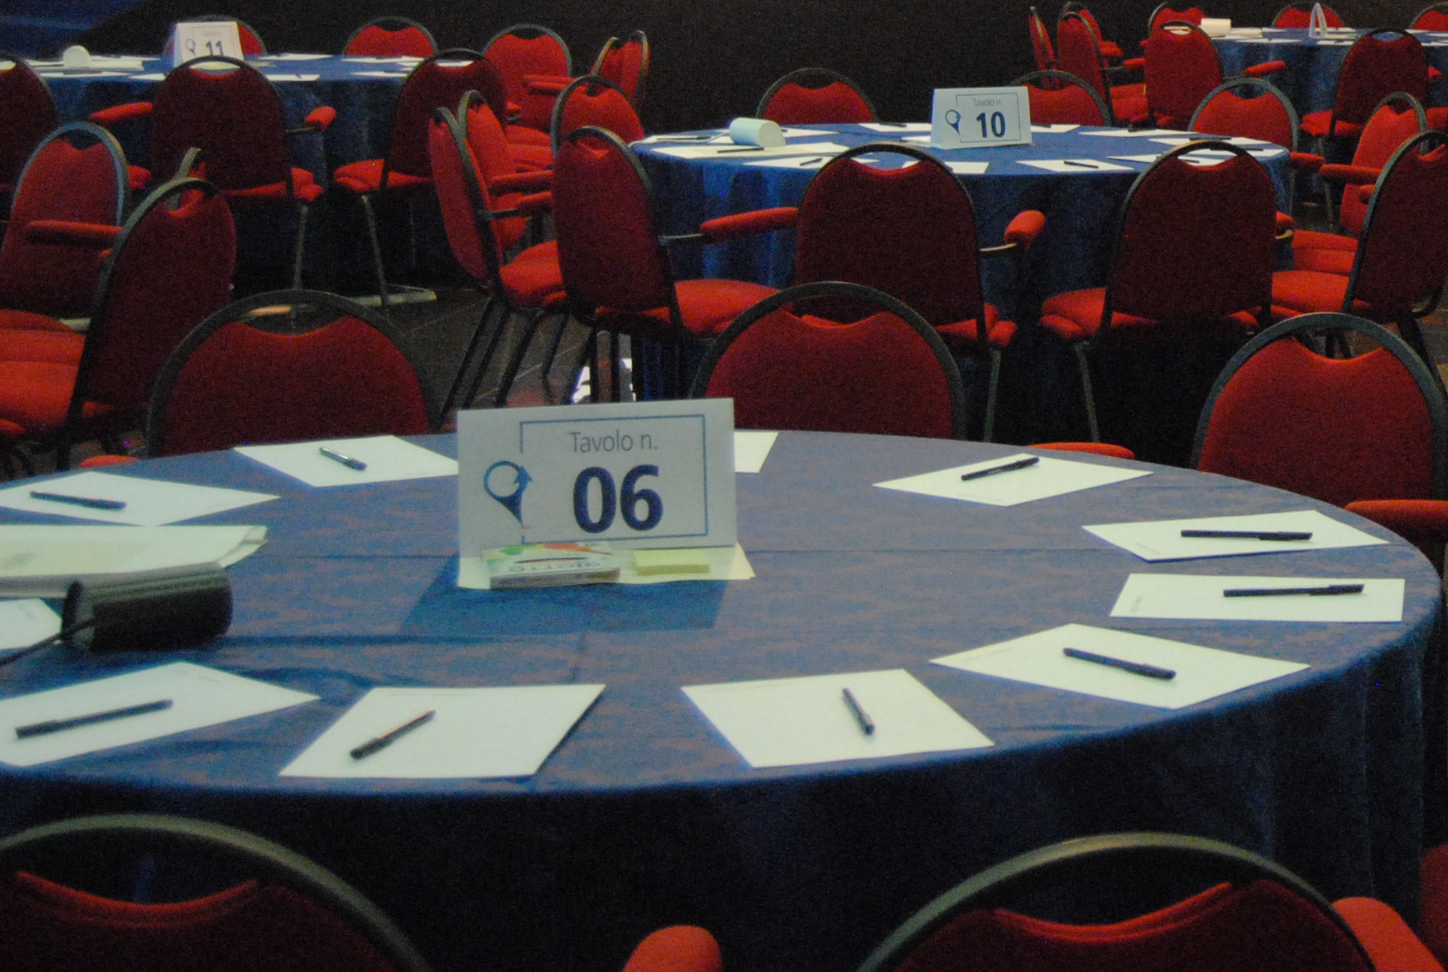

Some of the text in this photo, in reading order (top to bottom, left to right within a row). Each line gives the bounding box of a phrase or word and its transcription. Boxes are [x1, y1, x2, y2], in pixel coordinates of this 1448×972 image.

[205, 40, 224, 56] 11
[976, 111, 1006, 138] 10
[569, 429, 659, 454] Tavolo n.
[572, 463, 664, 534] 06
